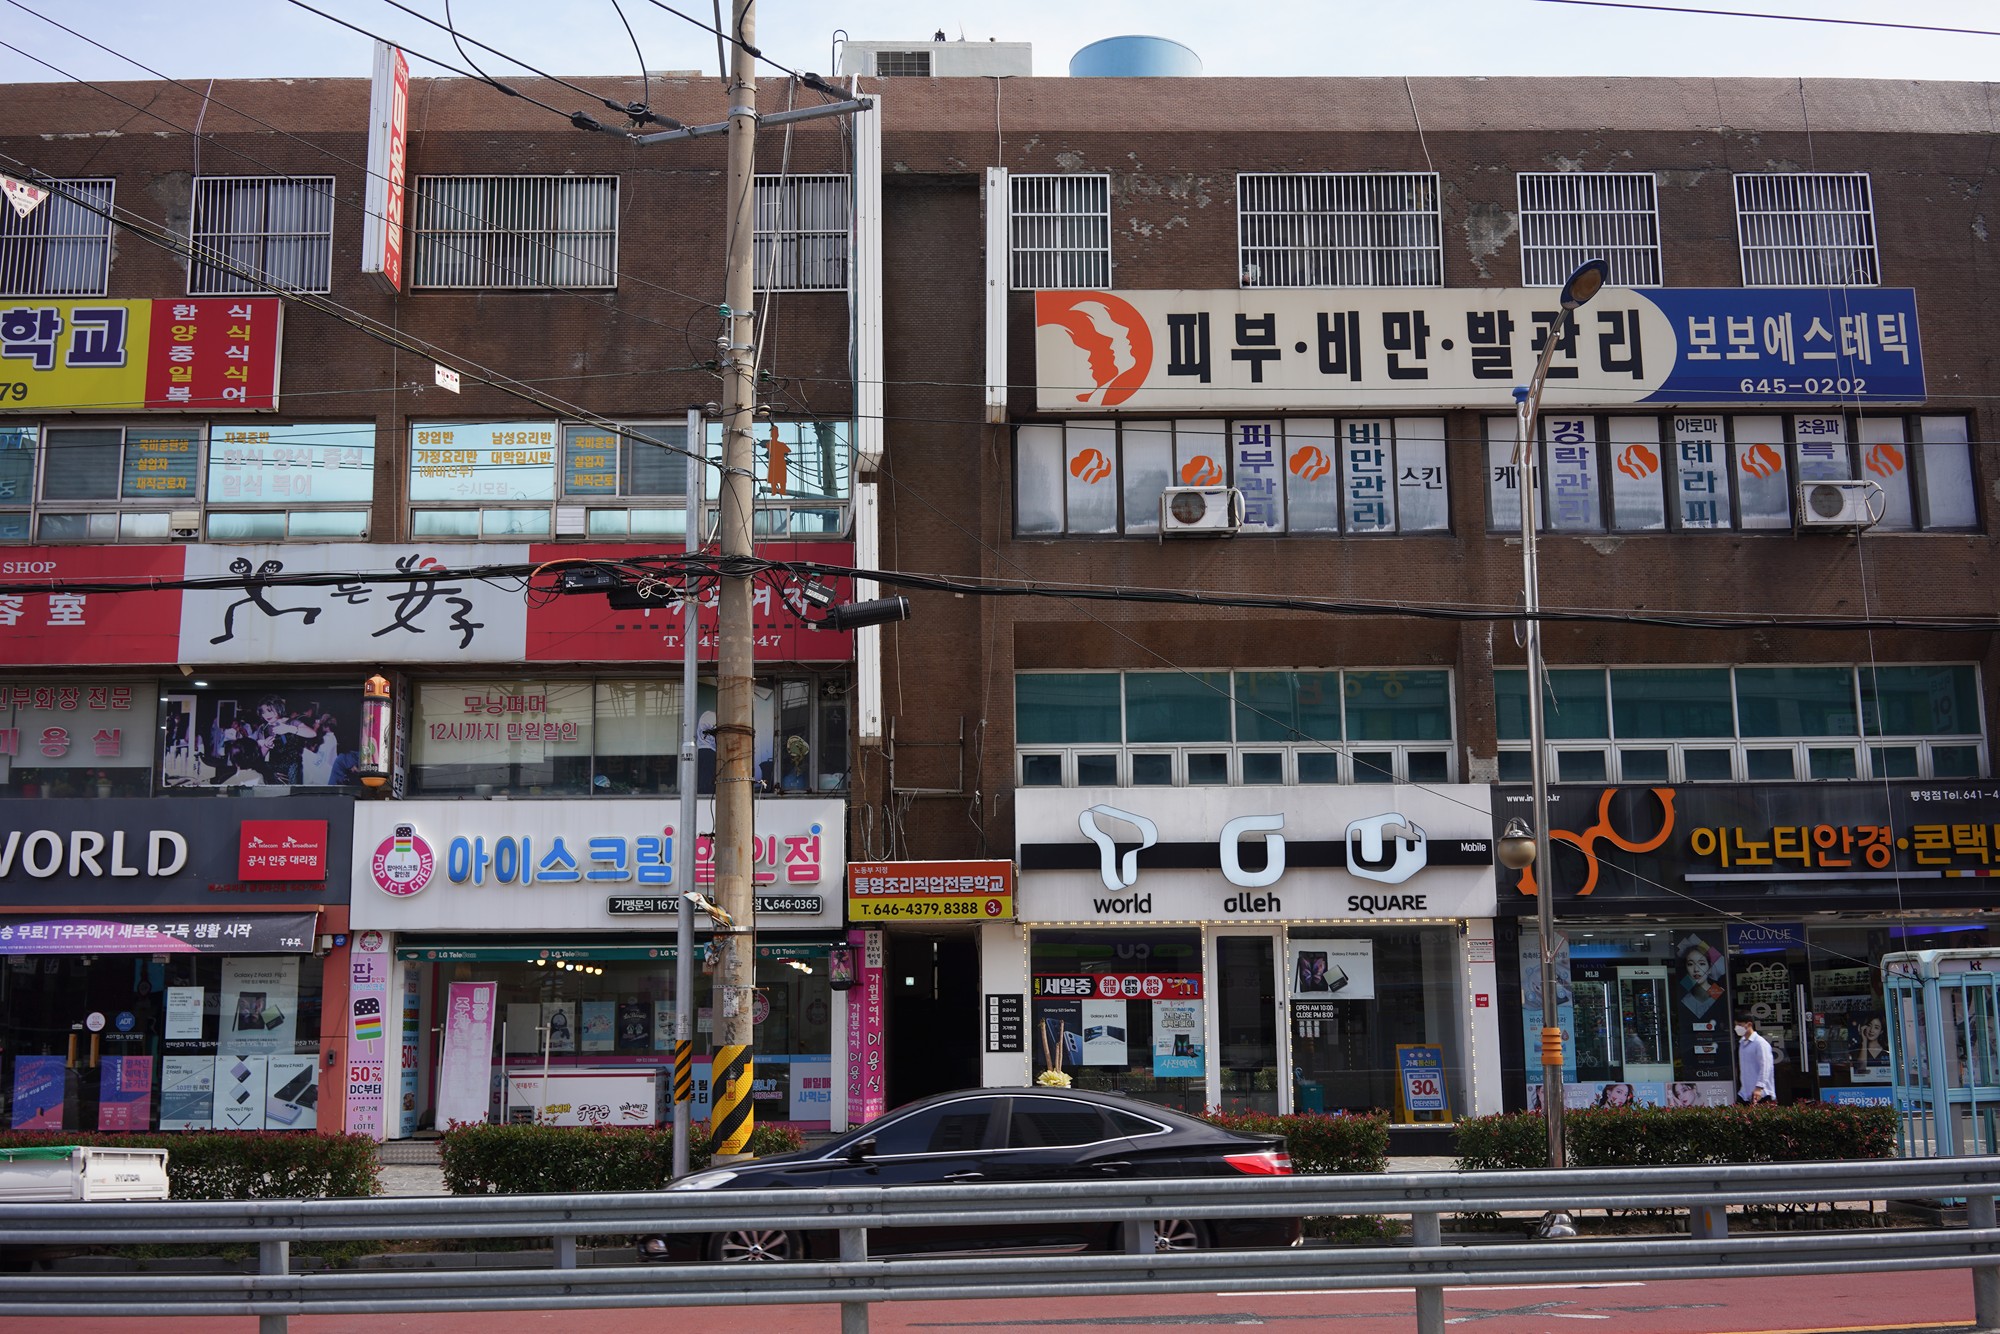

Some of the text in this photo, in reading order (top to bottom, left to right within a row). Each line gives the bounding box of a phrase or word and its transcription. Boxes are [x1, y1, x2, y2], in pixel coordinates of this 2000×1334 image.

[1688, 312, 1909, 365] 보보에스테틱
[1740, 378, 1867, 395] 645-0202
[1675, 418, 1718, 433] 아로마
[1798, 419, 1840, 435] 초음파
[418, 432, 551, 445] 창업반 남성요리반
[138, 458, 168, 470] 실업자
[417, 450, 551, 464] 가정요리반 대학입시반
[574, 456, 604, 468] 실업자
[1239, 424, 1276, 528] 피부관리
[1349, 422, 1385, 526] 비만관리
[1400, 466, 1442, 490] 스킨
[1552, 421, 1591, 523] 경락관리
[222, 474, 312, 496] 일식 복어
[1682, 440, 1718, 525] 테라피
[3, 562, 57, 574] SHOP
[88, 687, 131, 709] 전문
[464, 694, 547, 714] 모닝퍼머
[429, 722, 578, 741] 12시까지 만원할인
[1910, 790, 1942, 801] 통영점
[446, 824, 676, 887] 아이스크림
[1461, 842, 1487, 853] Mobile
[247, 855, 318, 866] 공식 인증 대리점
[374, 852, 433, 894] POP ICE CREAM
[854, 866, 888, 874] 노동부 지정
[855, 875, 1005, 895] 통영조리직업전문학교
[615, 899, 654, 911] 가맹문의
[773, 899, 818, 911] 646-0365
[1094, 893, 1152, 913] world
[1347, 895, 1427, 914] SQUARE
[17, 925, 49, 940] 무료!
[52, 924, 115, 940] T우주에서
[118, 924, 159, 939] 새로운
[162, 923, 190, 939] 구독
[193, 923, 220, 939] 생활
[223, 923, 252, 939] 시작
[1739, 929, 1792, 941] ACUVUE
[353, 958, 374, 984] 팝
[1970, 960, 1982, 971] kt
[1044, 978, 1092, 995] 세일중
[1103, 986, 1117, 994] 지원
[1750, 983, 1786, 991] 이노티
[867, 973, 881, 1027] 가위든여자
[850, 1003, 861, 1050] 가위든여자
[867, 1031, 882, 1093] 미용실
[849, 1052, 862, 1096] 미용실
[1696, 1070, 1719, 1078] Clalen
[350, 1084, 382, 1095] DC부터
[1411, 1079, 1439, 1096] 30%
